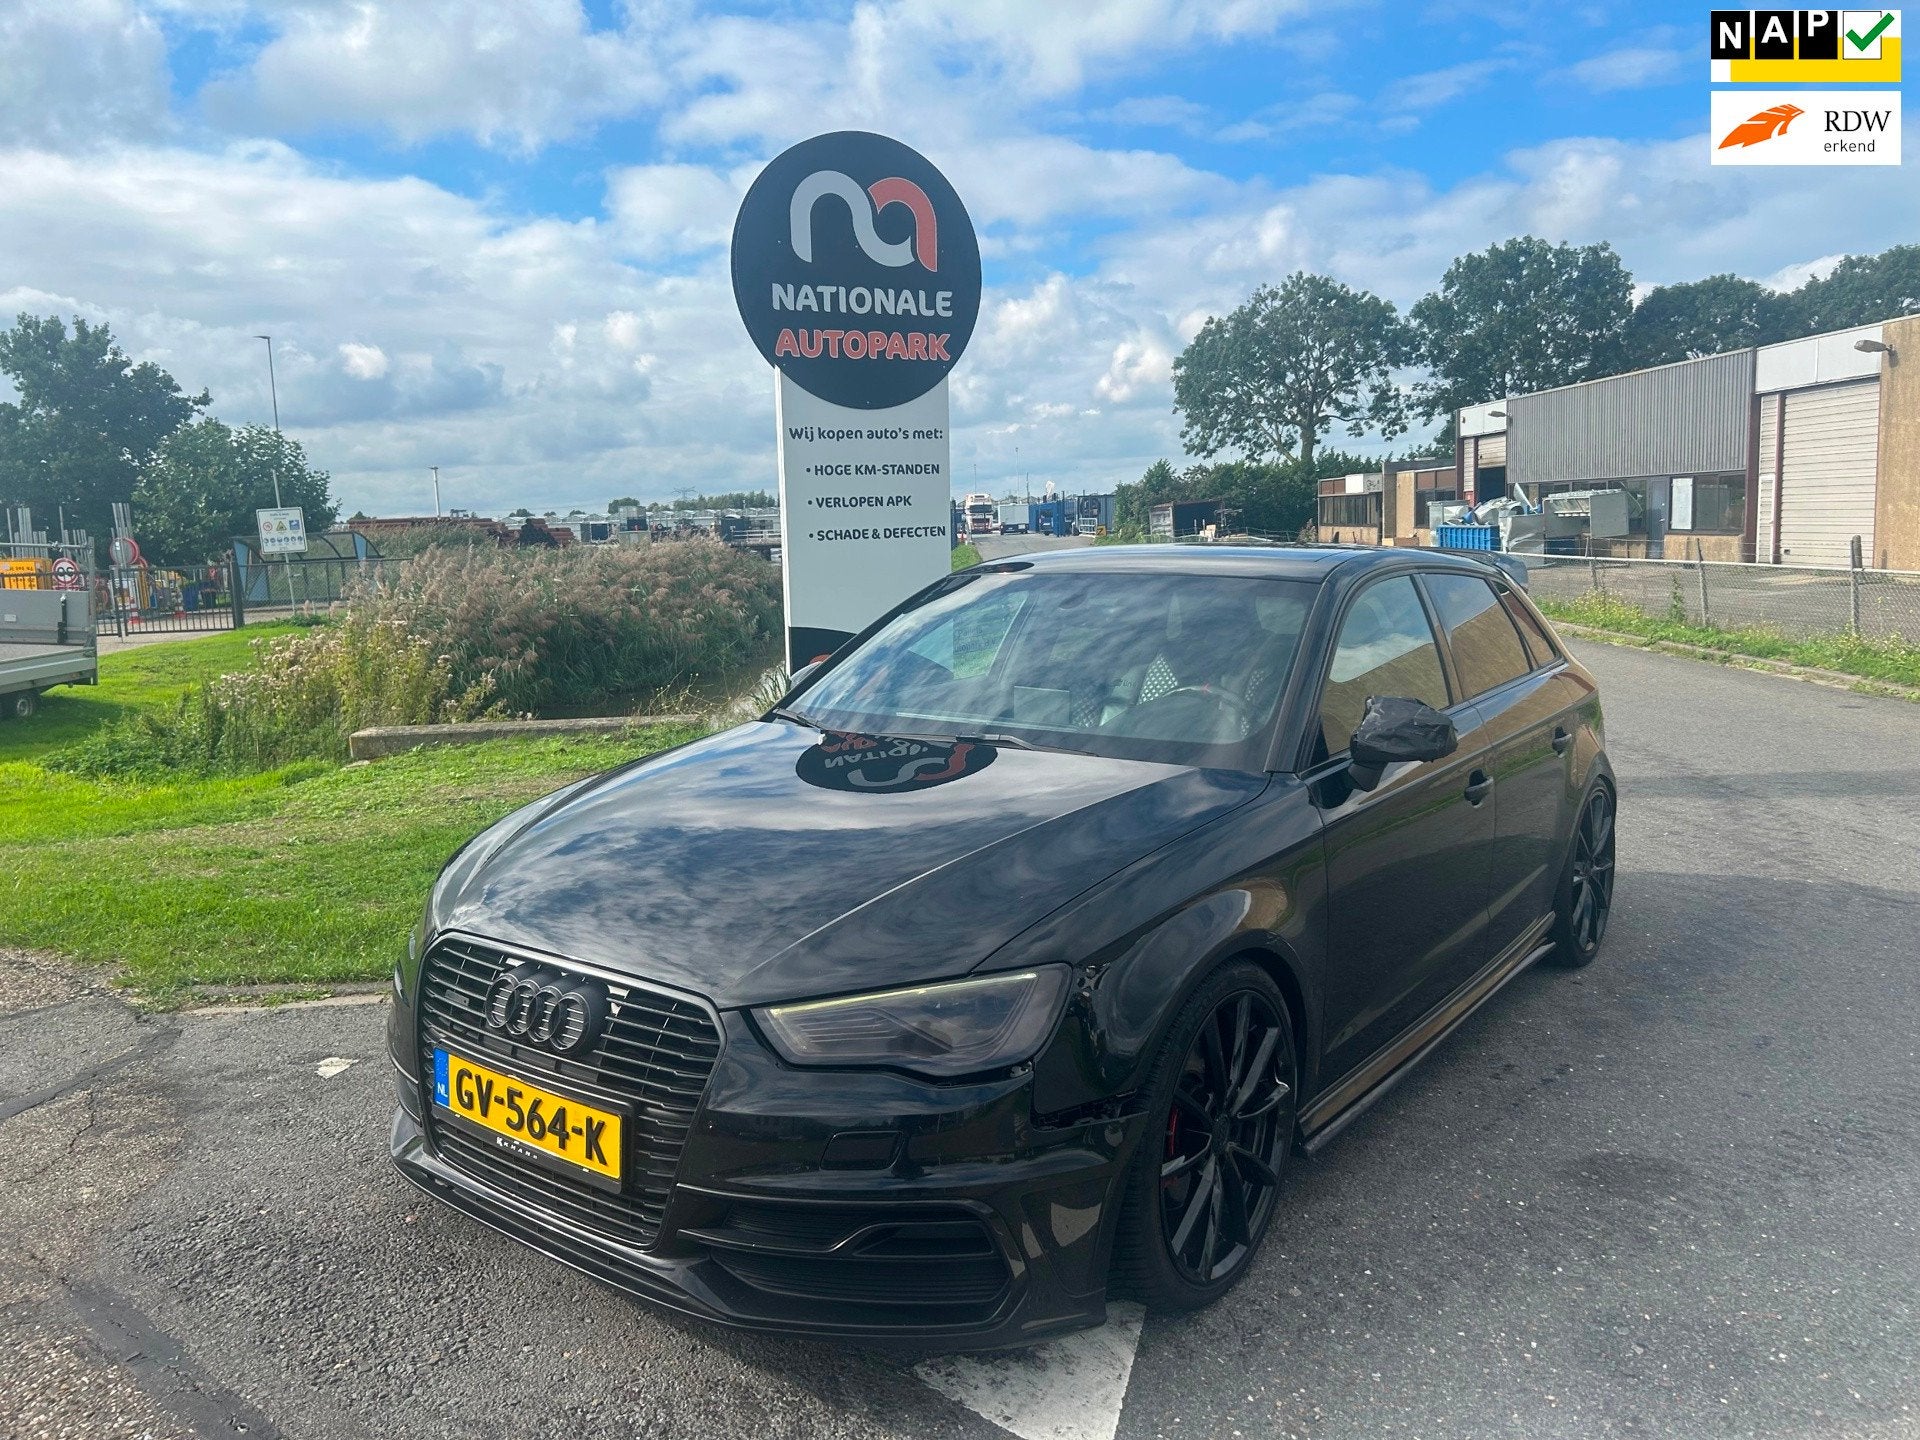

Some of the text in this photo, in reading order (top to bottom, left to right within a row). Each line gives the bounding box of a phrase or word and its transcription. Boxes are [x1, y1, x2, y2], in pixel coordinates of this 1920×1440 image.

[772, 283, 953, 317] NATIONALE
[775, 328, 951, 361] AUTOPARK
[788, 427, 943, 442] Wij kopen auto's met:
[814, 464, 940, 476] HOGE KM-STANDEN
[816, 495, 912, 508] VERLOPEN APK
[817, 526, 946, 541] SCHADE & DEFECTEN
[437, 1081, 448, 1097] NL
[455, 1067, 608, 1166] GV-564-K
